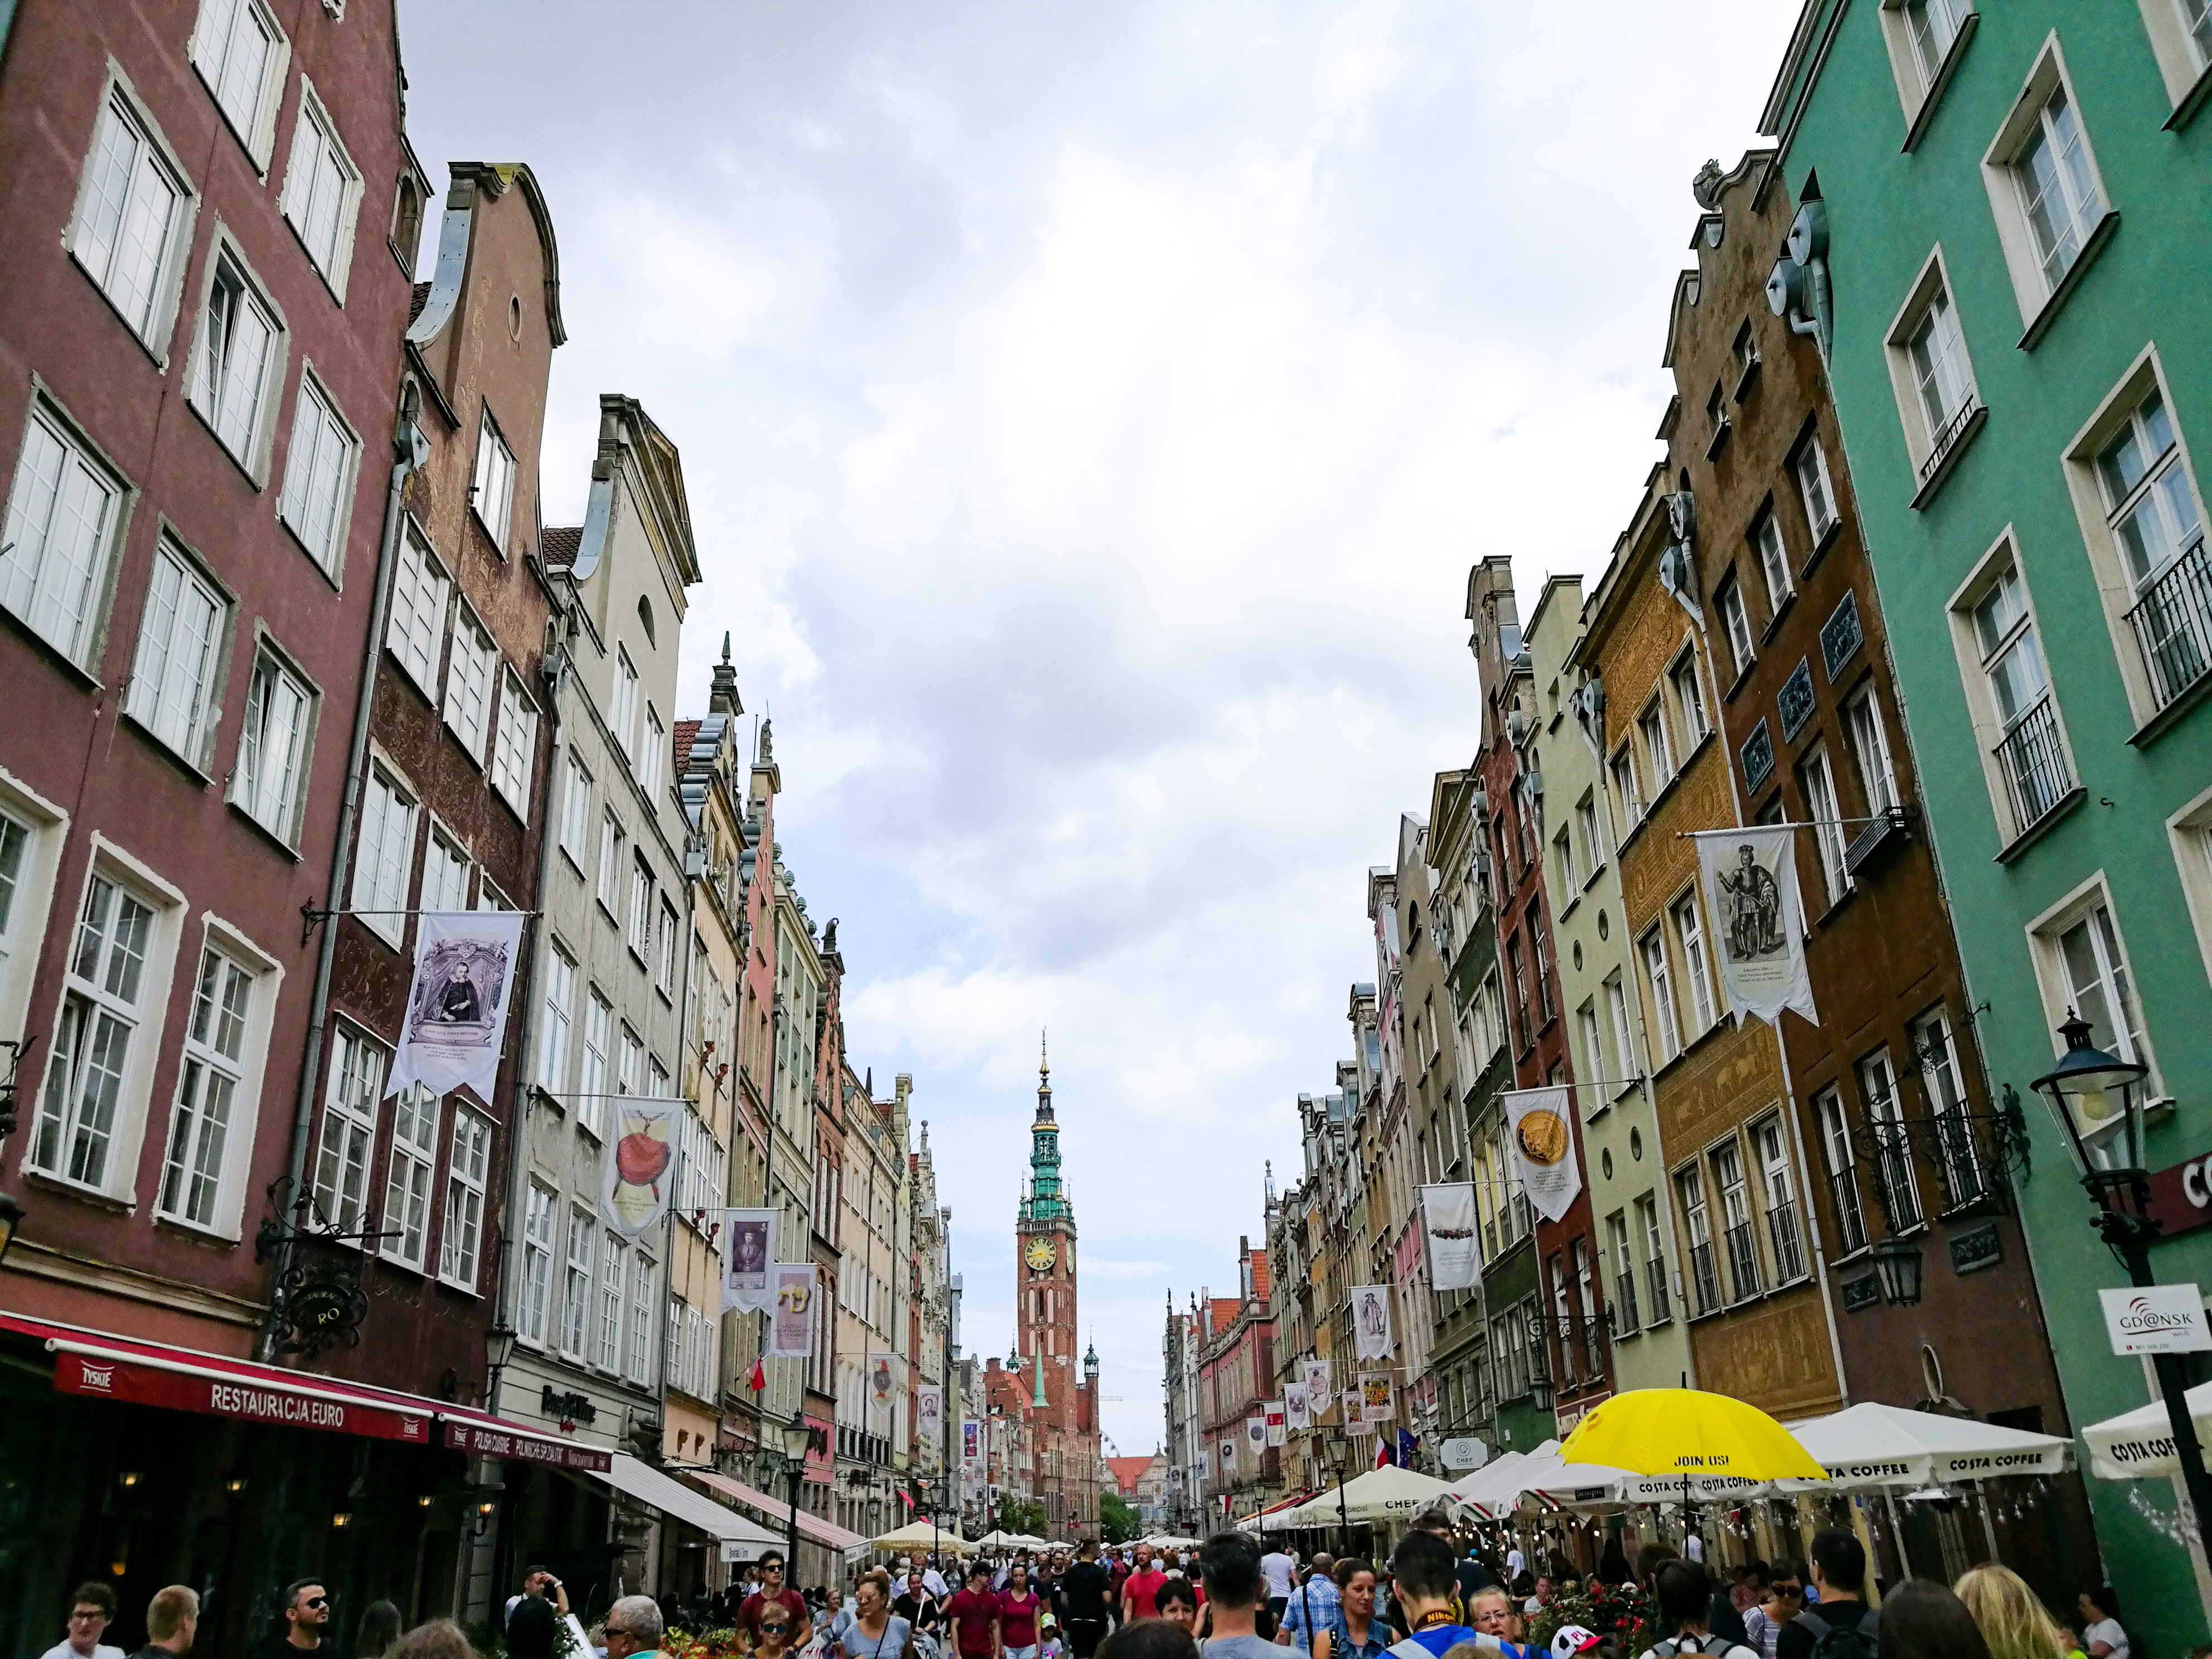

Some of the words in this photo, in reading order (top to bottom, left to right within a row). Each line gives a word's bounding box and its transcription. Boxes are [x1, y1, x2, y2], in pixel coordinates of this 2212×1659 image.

[83, 1367, 111, 1388] TYSKIE
[312, 1402, 344, 1428] EURO
[474, 1430, 492, 1451] POLISH
[2111, 1442, 2150, 1462] COSTA
[1674, 1456, 1704, 1467] JOIN
[1709, 1455, 1729, 1466] US!
[1950, 1457, 1990, 1471] COSTA
[1995, 1453, 2042, 1467] COFFEE
[1850, 1463, 1909, 1478] COFFEE
[1639, 1481, 1671, 1493] COSTA
[1702, 1478, 1726, 1491] COSTA
[1347, 1505, 1368, 1514] pepsi
[1385, 1499, 1419, 1509] CHEF
